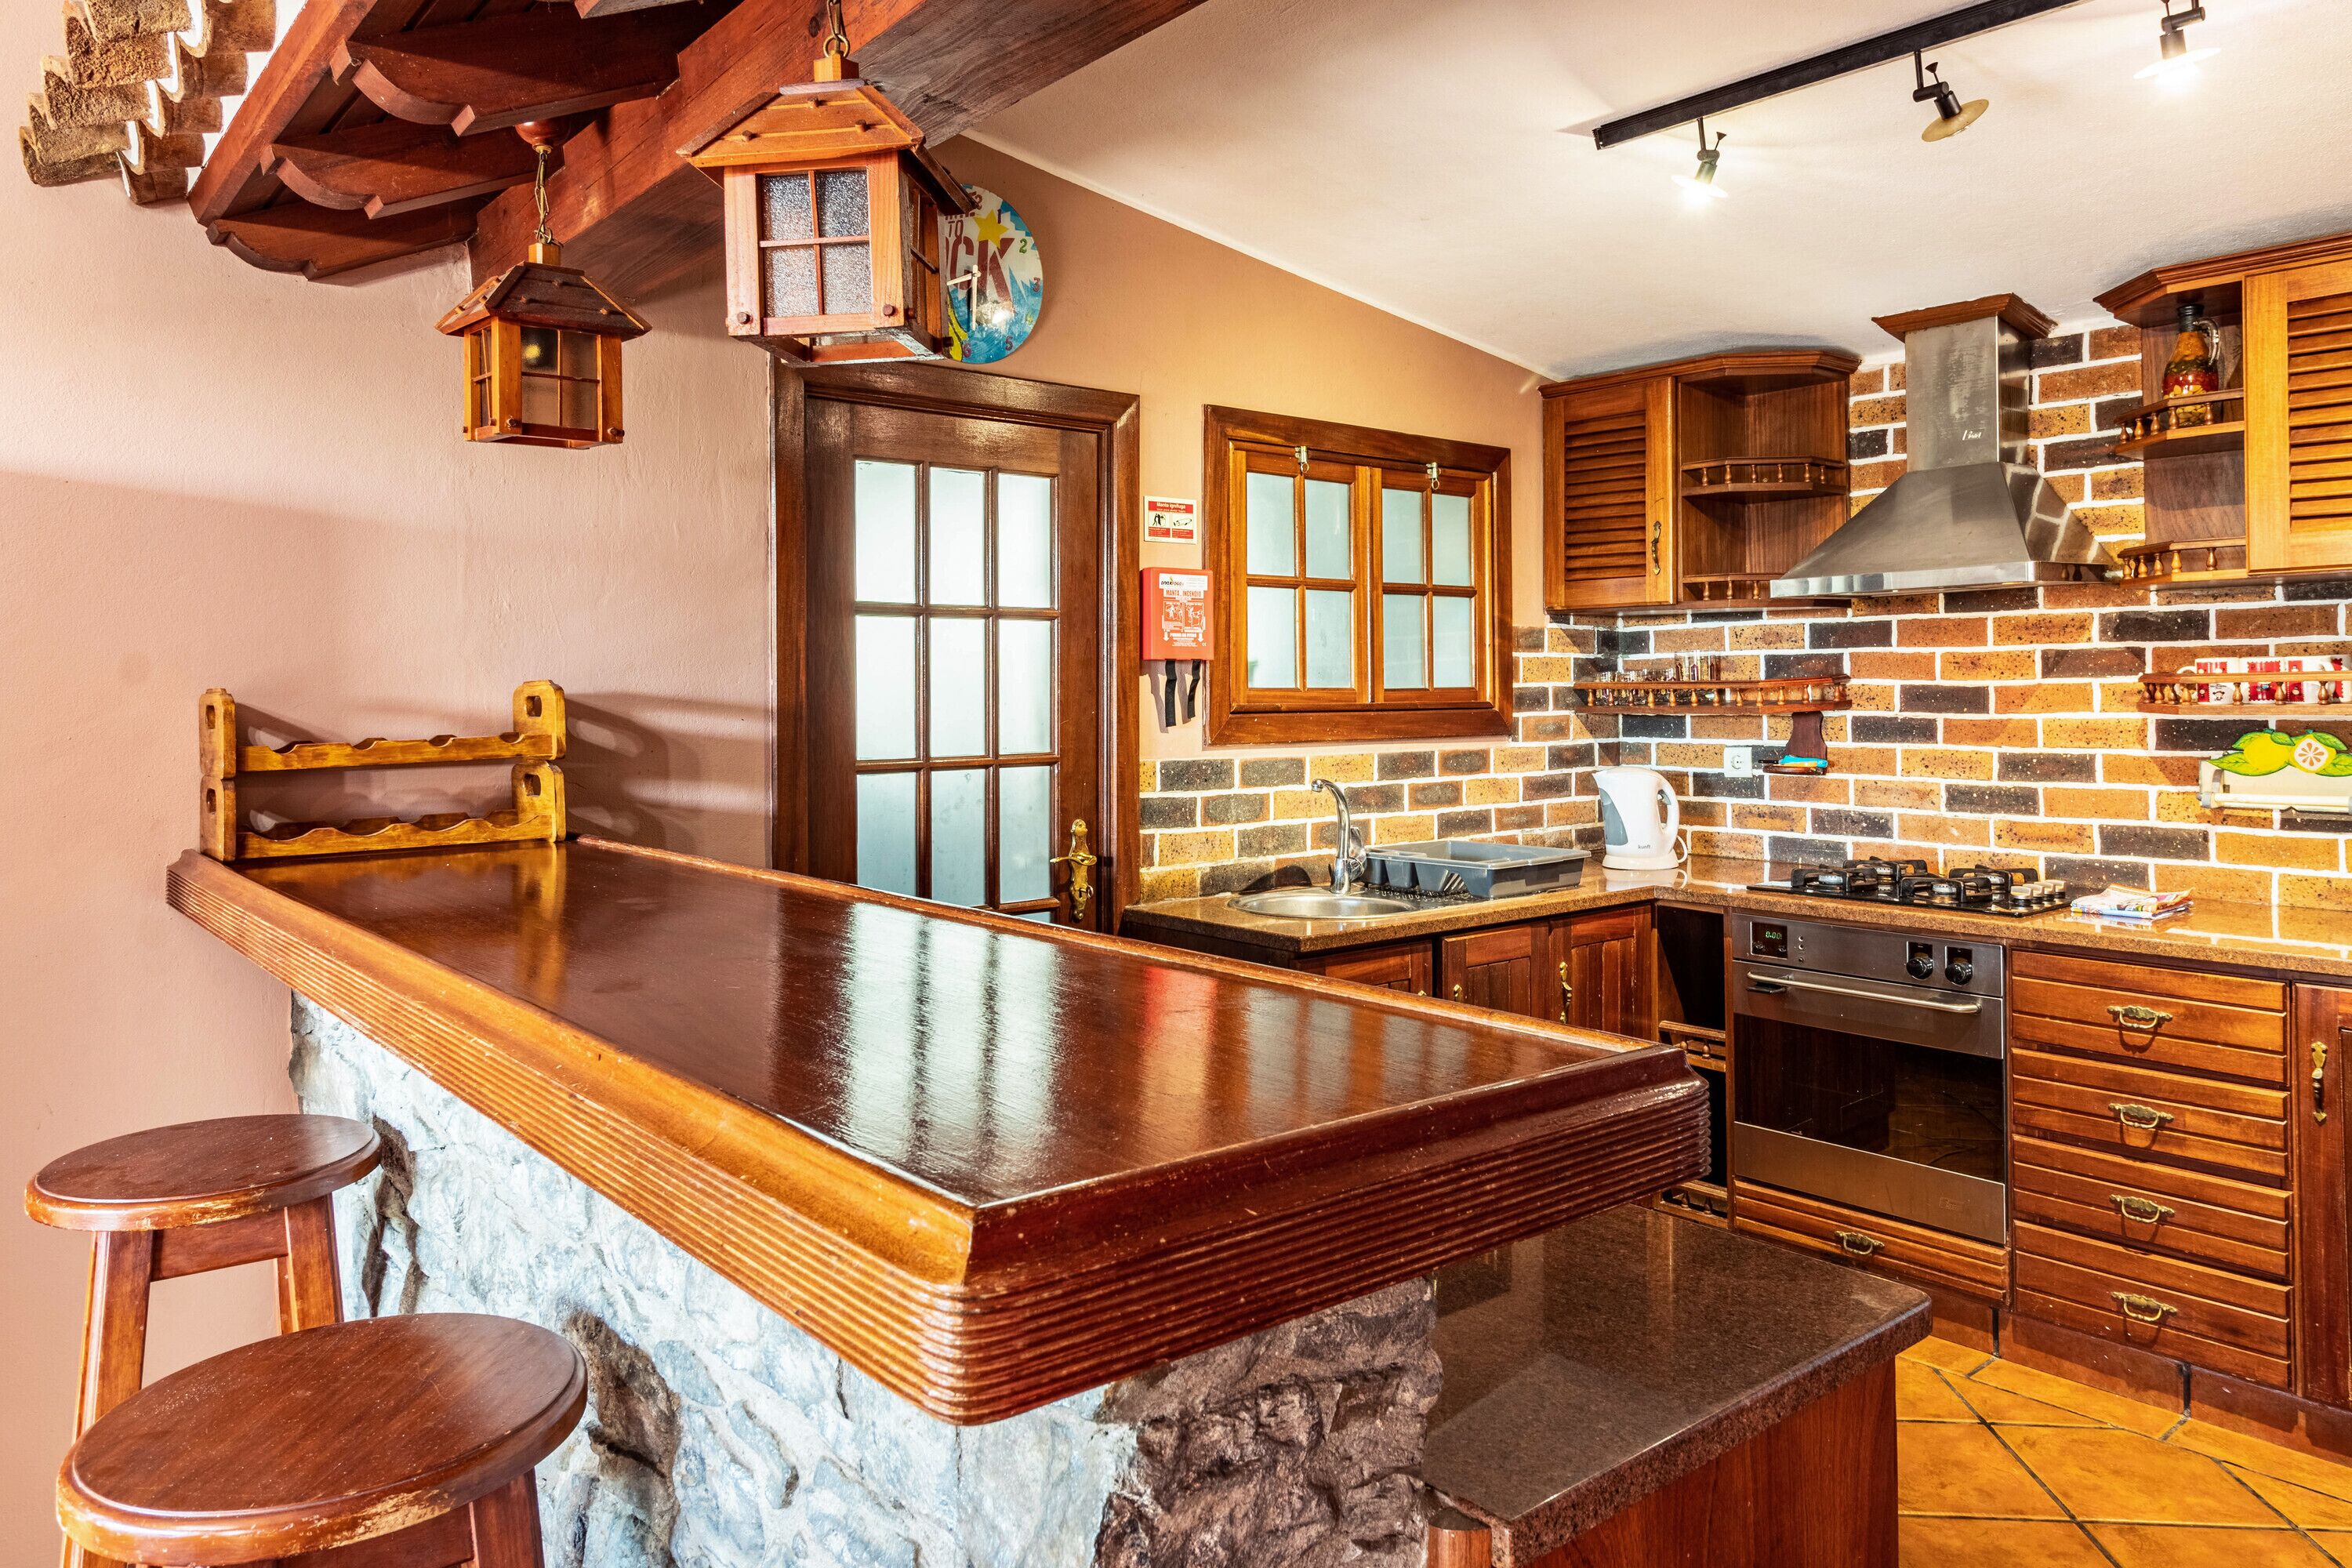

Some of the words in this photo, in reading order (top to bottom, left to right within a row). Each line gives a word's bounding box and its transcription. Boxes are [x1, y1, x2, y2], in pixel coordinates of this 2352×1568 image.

[997, 209, 1003, 224] 1
[947, 219, 964, 238] TO
[1019, 238, 1028, 254] 2
[946, 235, 1016, 314] CK
[1033, 277, 1041, 292] 3
[963, 343, 972, 358] 6
[1005, 336, 1014, 350] 5
